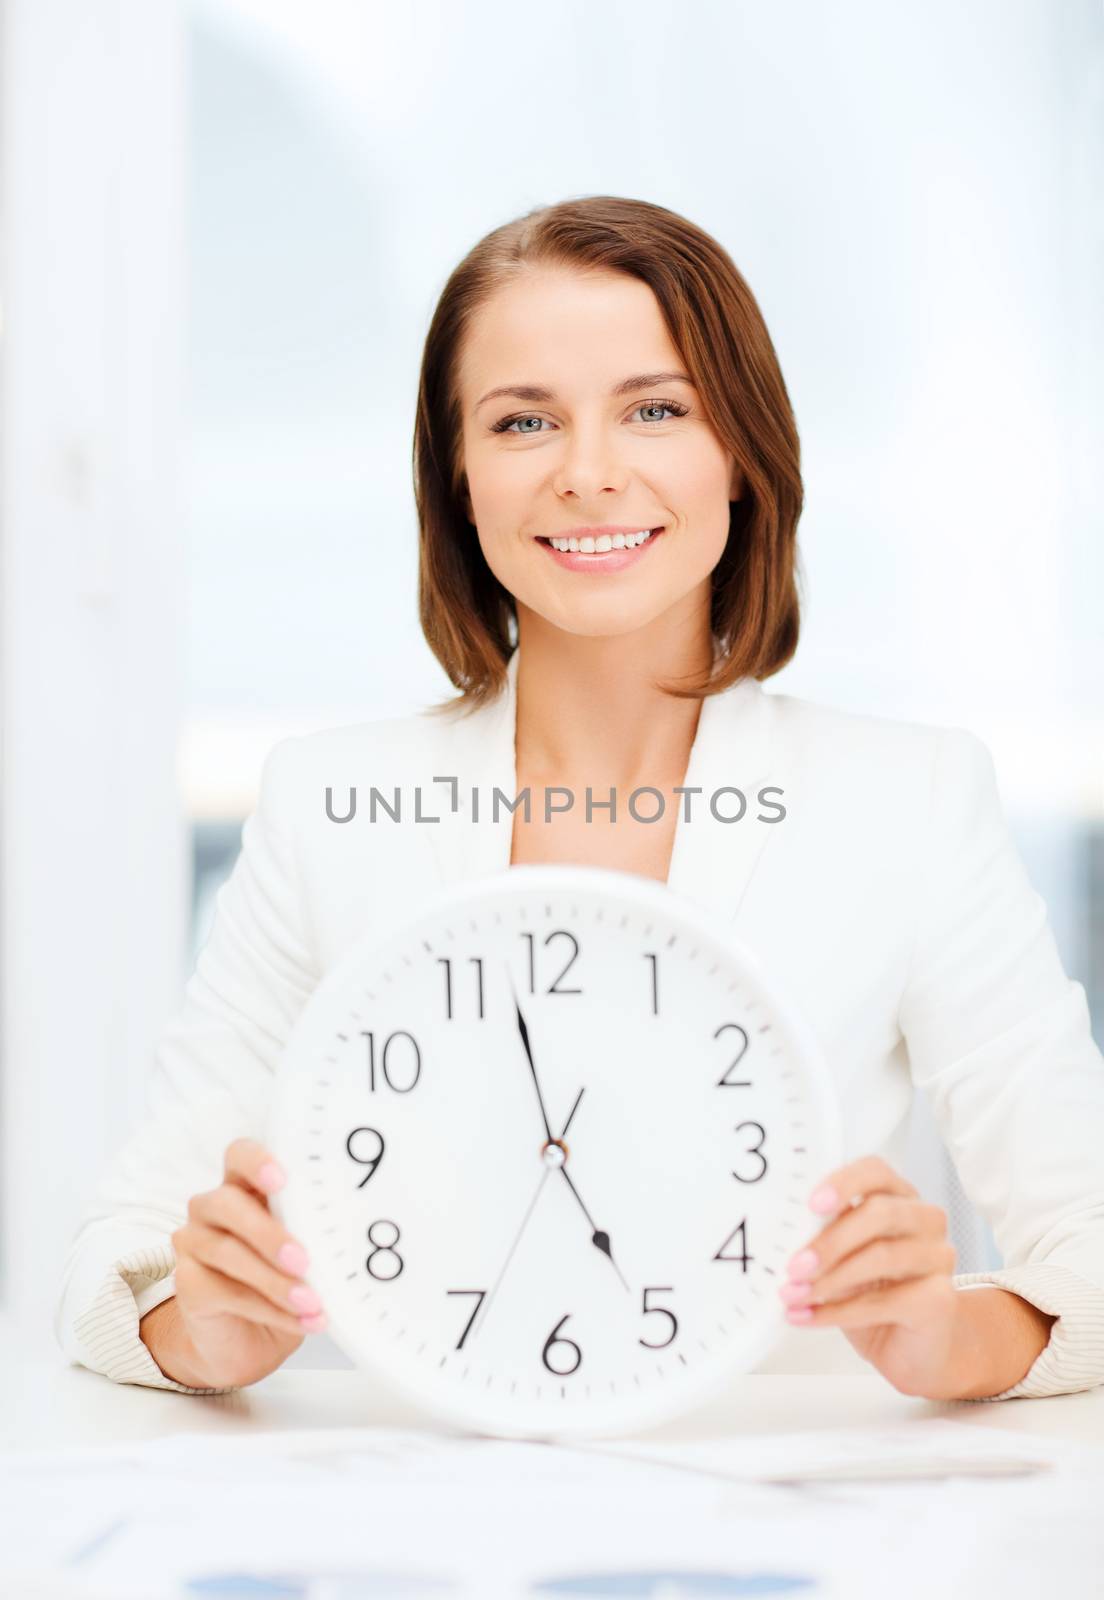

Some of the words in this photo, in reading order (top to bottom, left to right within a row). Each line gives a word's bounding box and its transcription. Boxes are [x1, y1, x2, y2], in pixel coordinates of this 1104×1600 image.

[437, 957, 486, 1020] 11
[520, 930, 583, 995] 12
[643, 953, 659, 1016] 1
[360, 1030, 422, 1094] 10
[713, 1023, 752, 1087] 2
[346, 1126, 386, 1189] 9
[731, 1121, 768, 1184] 3
[365, 1219, 405, 1282] 8
[712, 1217, 754, 1274] 4
[446, 1289, 487, 1351] 7
[541, 1313, 583, 1377] 6
[638, 1286, 679, 1350] 5
